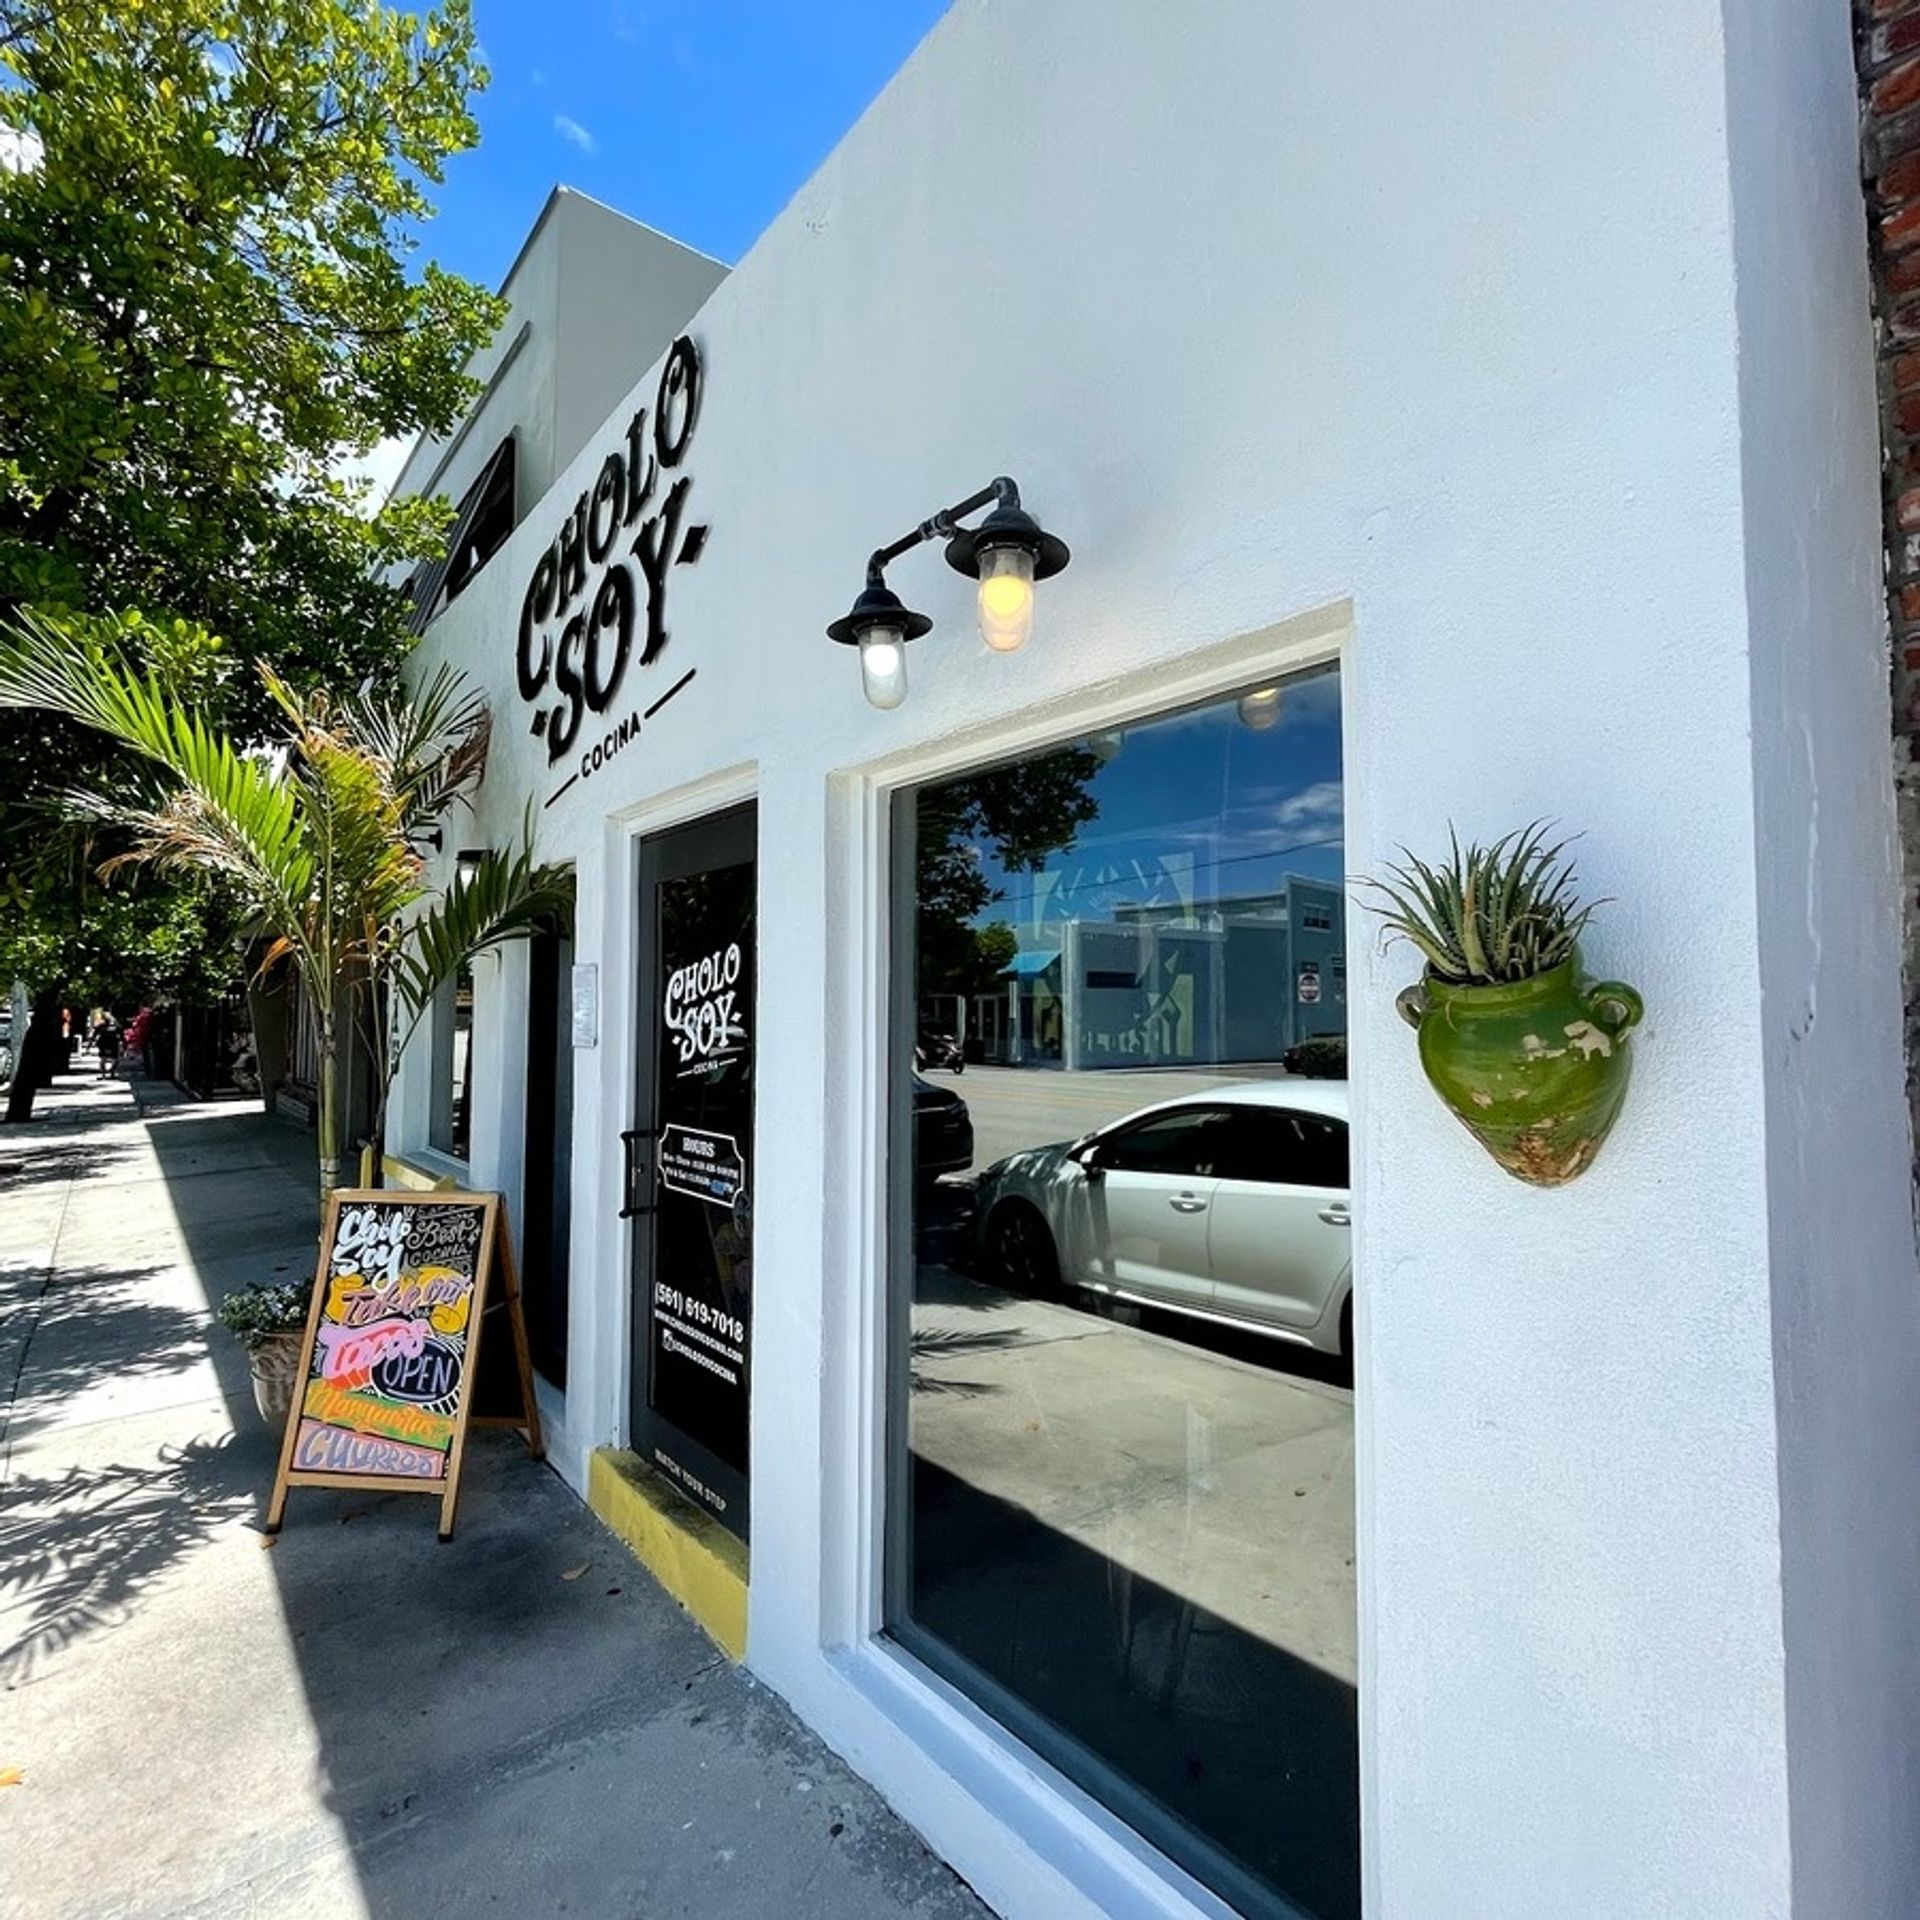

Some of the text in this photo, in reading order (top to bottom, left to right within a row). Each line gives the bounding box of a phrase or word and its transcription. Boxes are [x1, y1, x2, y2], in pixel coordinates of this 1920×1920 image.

[516, 334, 702, 702] CHOLO
[548, 476, 689, 768] SOY
[580, 712, 642, 778] COCINA
[665, 942, 741, 1030] CHOLO
[680, 990, 736, 1062] SOY
[655, 1282, 684, 1316] (561)
[382, 1350, 453, 1394] OPEN
